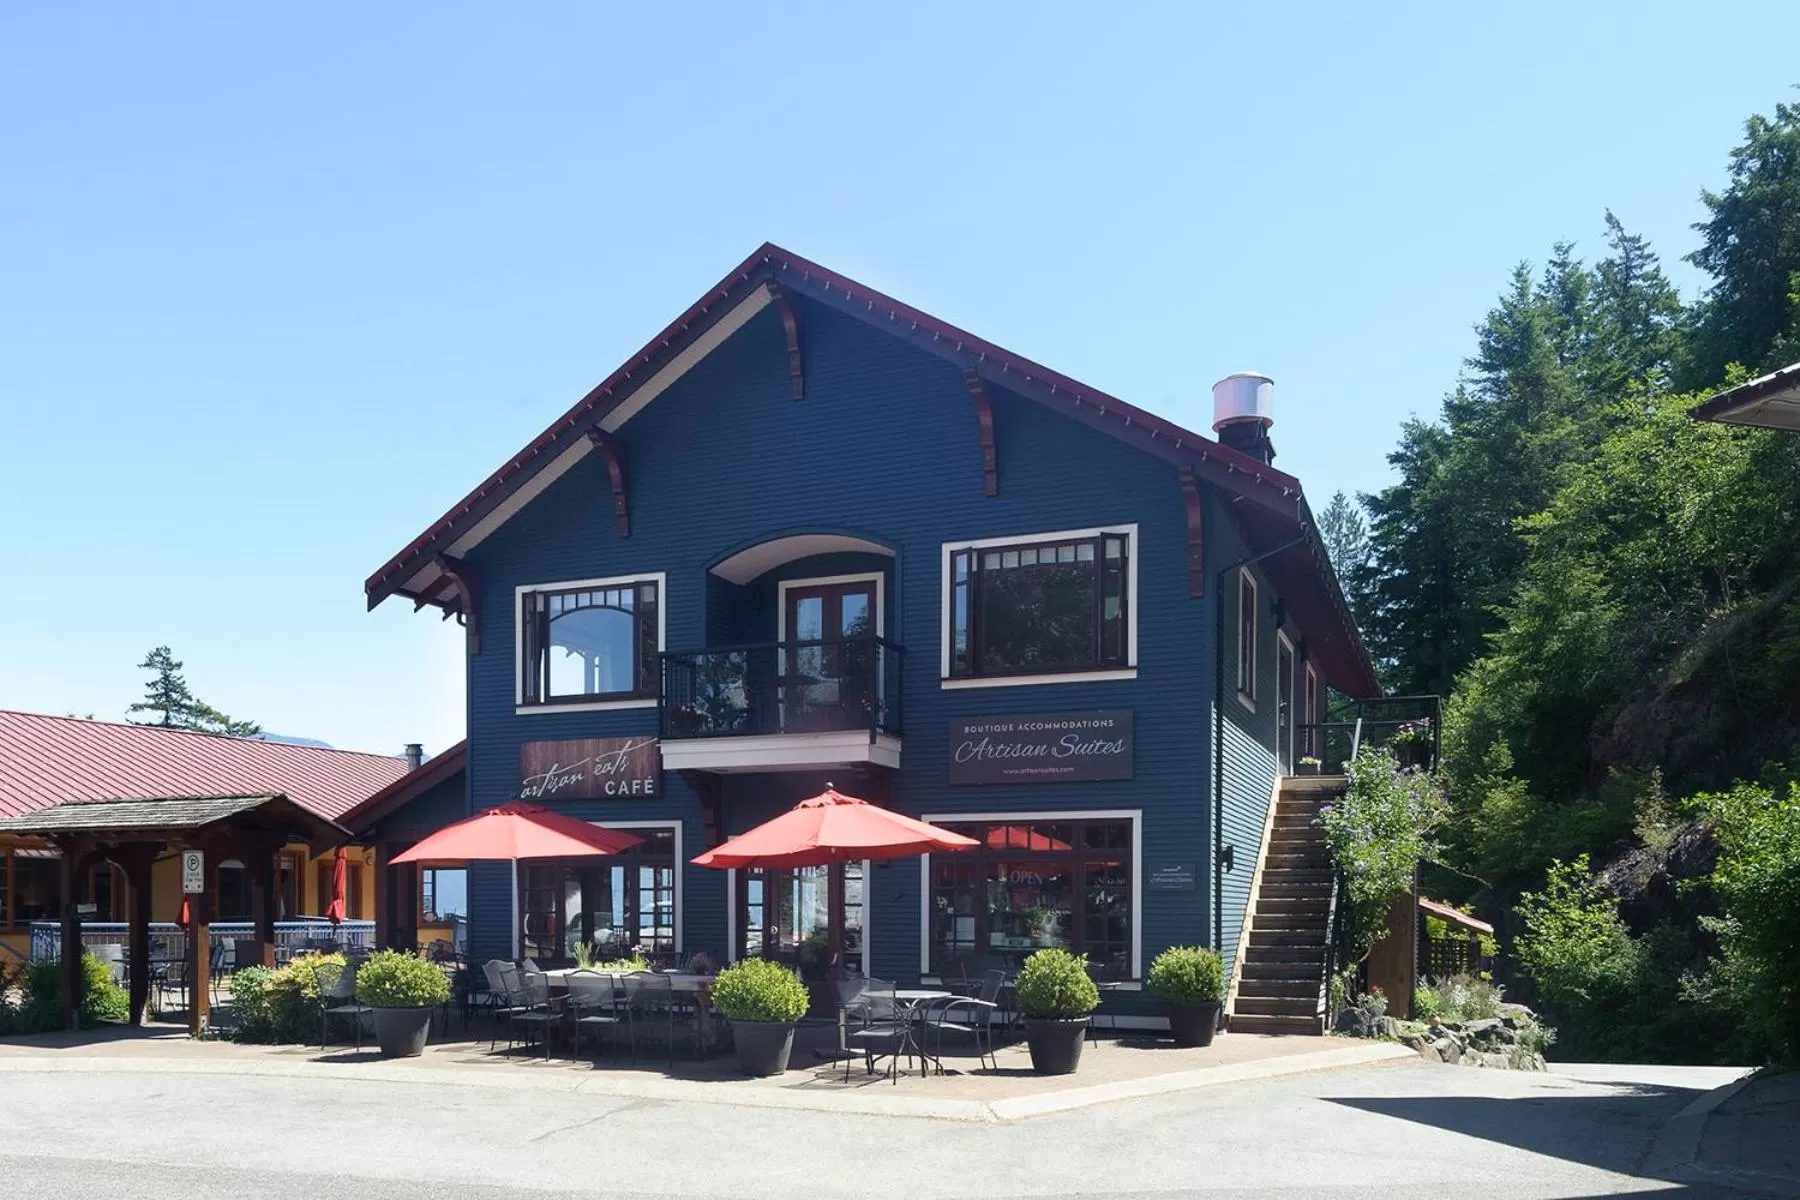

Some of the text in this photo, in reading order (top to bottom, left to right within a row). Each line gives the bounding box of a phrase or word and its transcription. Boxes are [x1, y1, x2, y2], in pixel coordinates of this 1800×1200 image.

[964, 719, 1115, 733] BOUTIQUE ACCOMMODATIONS
[955, 734, 1127, 763] Artisan Suites
[520, 737, 658, 799] artisan eats
[605, 776, 654, 795] CAFÉ
[1010, 870, 1044, 885] OPEN
